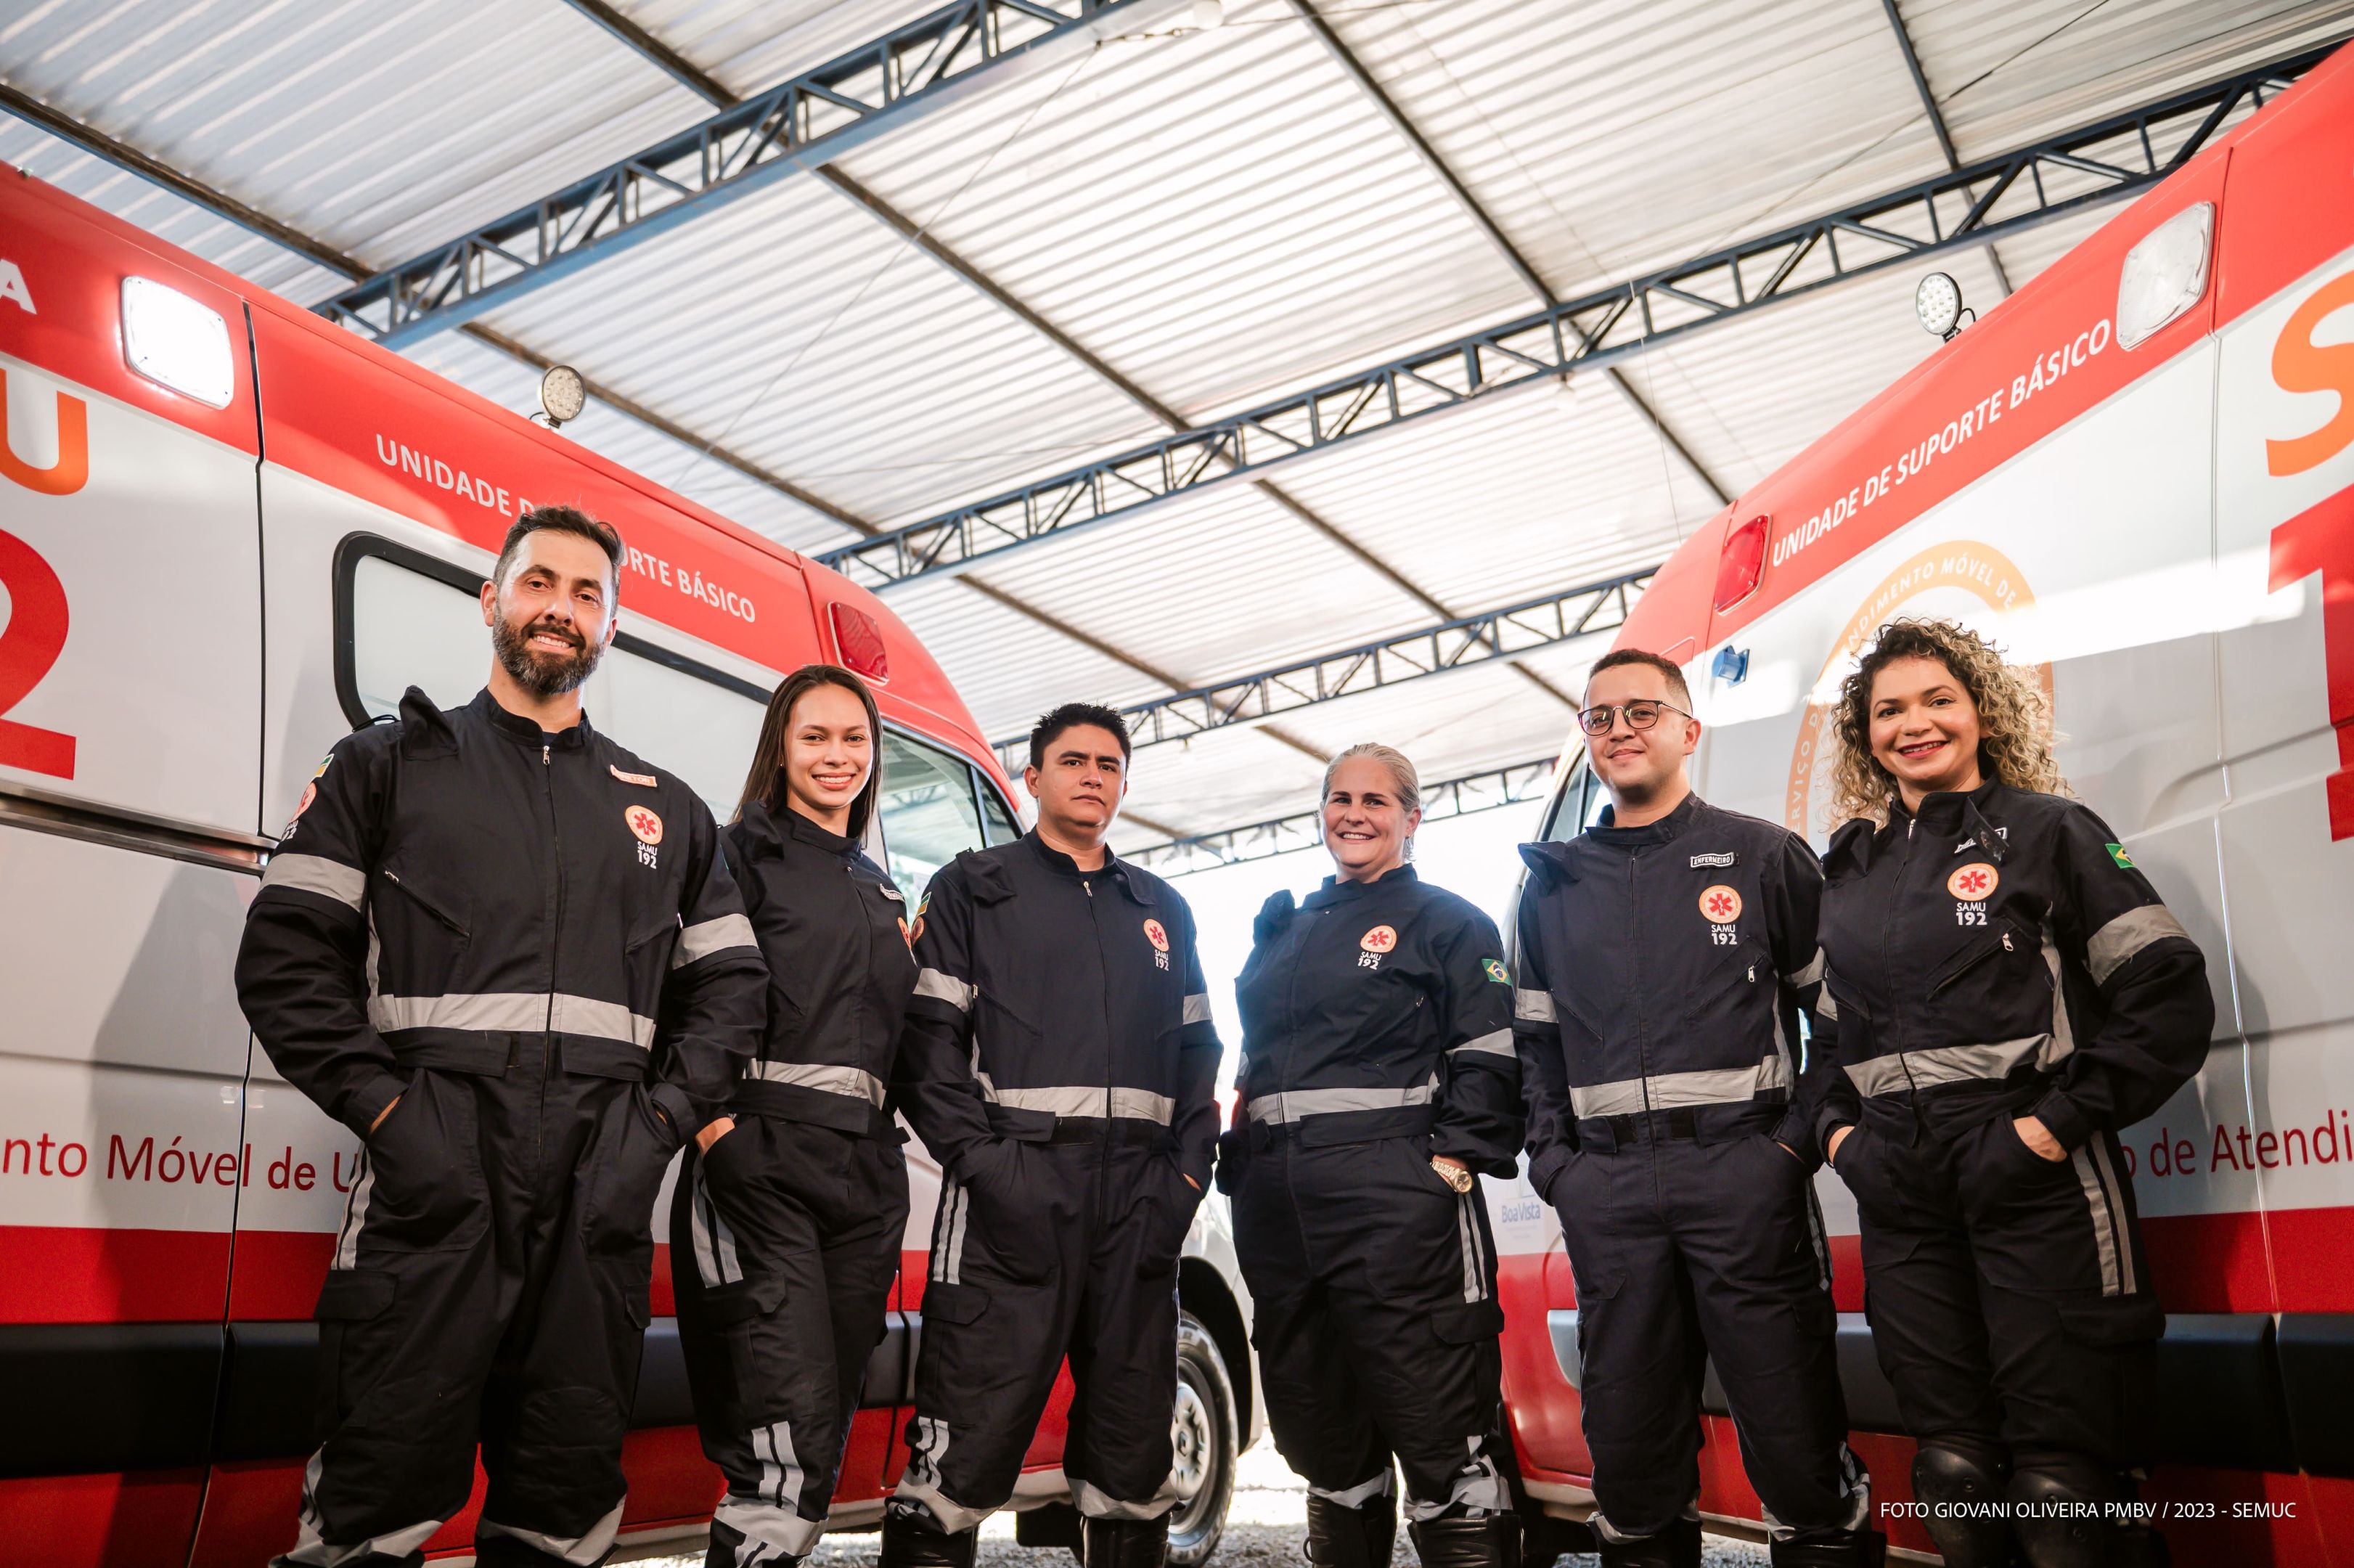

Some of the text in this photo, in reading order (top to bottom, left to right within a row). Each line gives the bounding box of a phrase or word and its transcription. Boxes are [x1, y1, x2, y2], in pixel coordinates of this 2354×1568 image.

[1773, 318, 2112, 568] UNIDADE DE SUPORTE BÁSICO
[376, 433, 512, 518] UNIDADE
[677, 571, 756, 624] BÁSICO
[1791, 740, 1811, 833] ERVIÇO
[1940, 552, 1993, 589] MÓVEL
[1995, 579, 2016, 609] DE
[637, 841, 658, 857] SAMU
[637, 849, 658, 870] 192
[1693, 855, 1730, 865] ENFERMEIRO
[1956, 902, 1987, 912] SAMU
[1955, 912, 1988, 926] 192
[1711, 924, 1736, 933] SAMU
[1711, 933, 1738, 945] 192
[1154, 949, 1169, 960] SAMU
[1360, 951, 1382, 961] SAMU
[1155, 956, 1169, 971] 192
[1357, 957, 1379, 970] 192
[2149, 1127, 2196, 1177] de
[2211, 1108, 2354, 1173] Atendi
[3, 1132, 88, 1177] nto
[107, 1134, 252, 1188] Móvel
[266, 1146, 316, 1191] de
[1502, 1203, 1540, 1222] BoaVista
